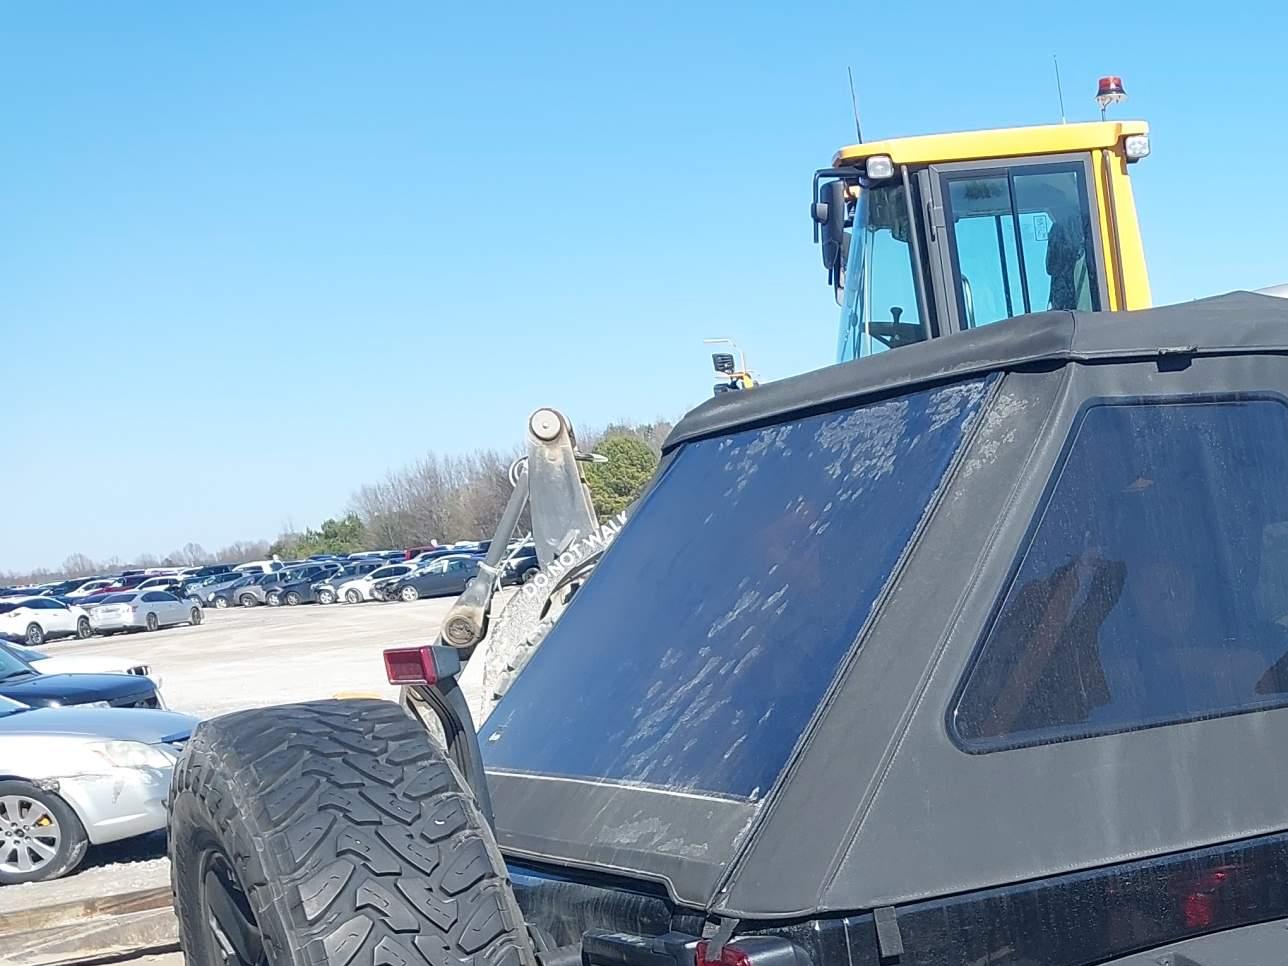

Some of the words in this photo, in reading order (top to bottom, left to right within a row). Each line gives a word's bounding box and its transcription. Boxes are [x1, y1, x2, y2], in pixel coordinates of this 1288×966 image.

[522, 573, 549, 595] DO
[546, 543, 583, 578] NOT
[582, 510, 628, 550] WALK
